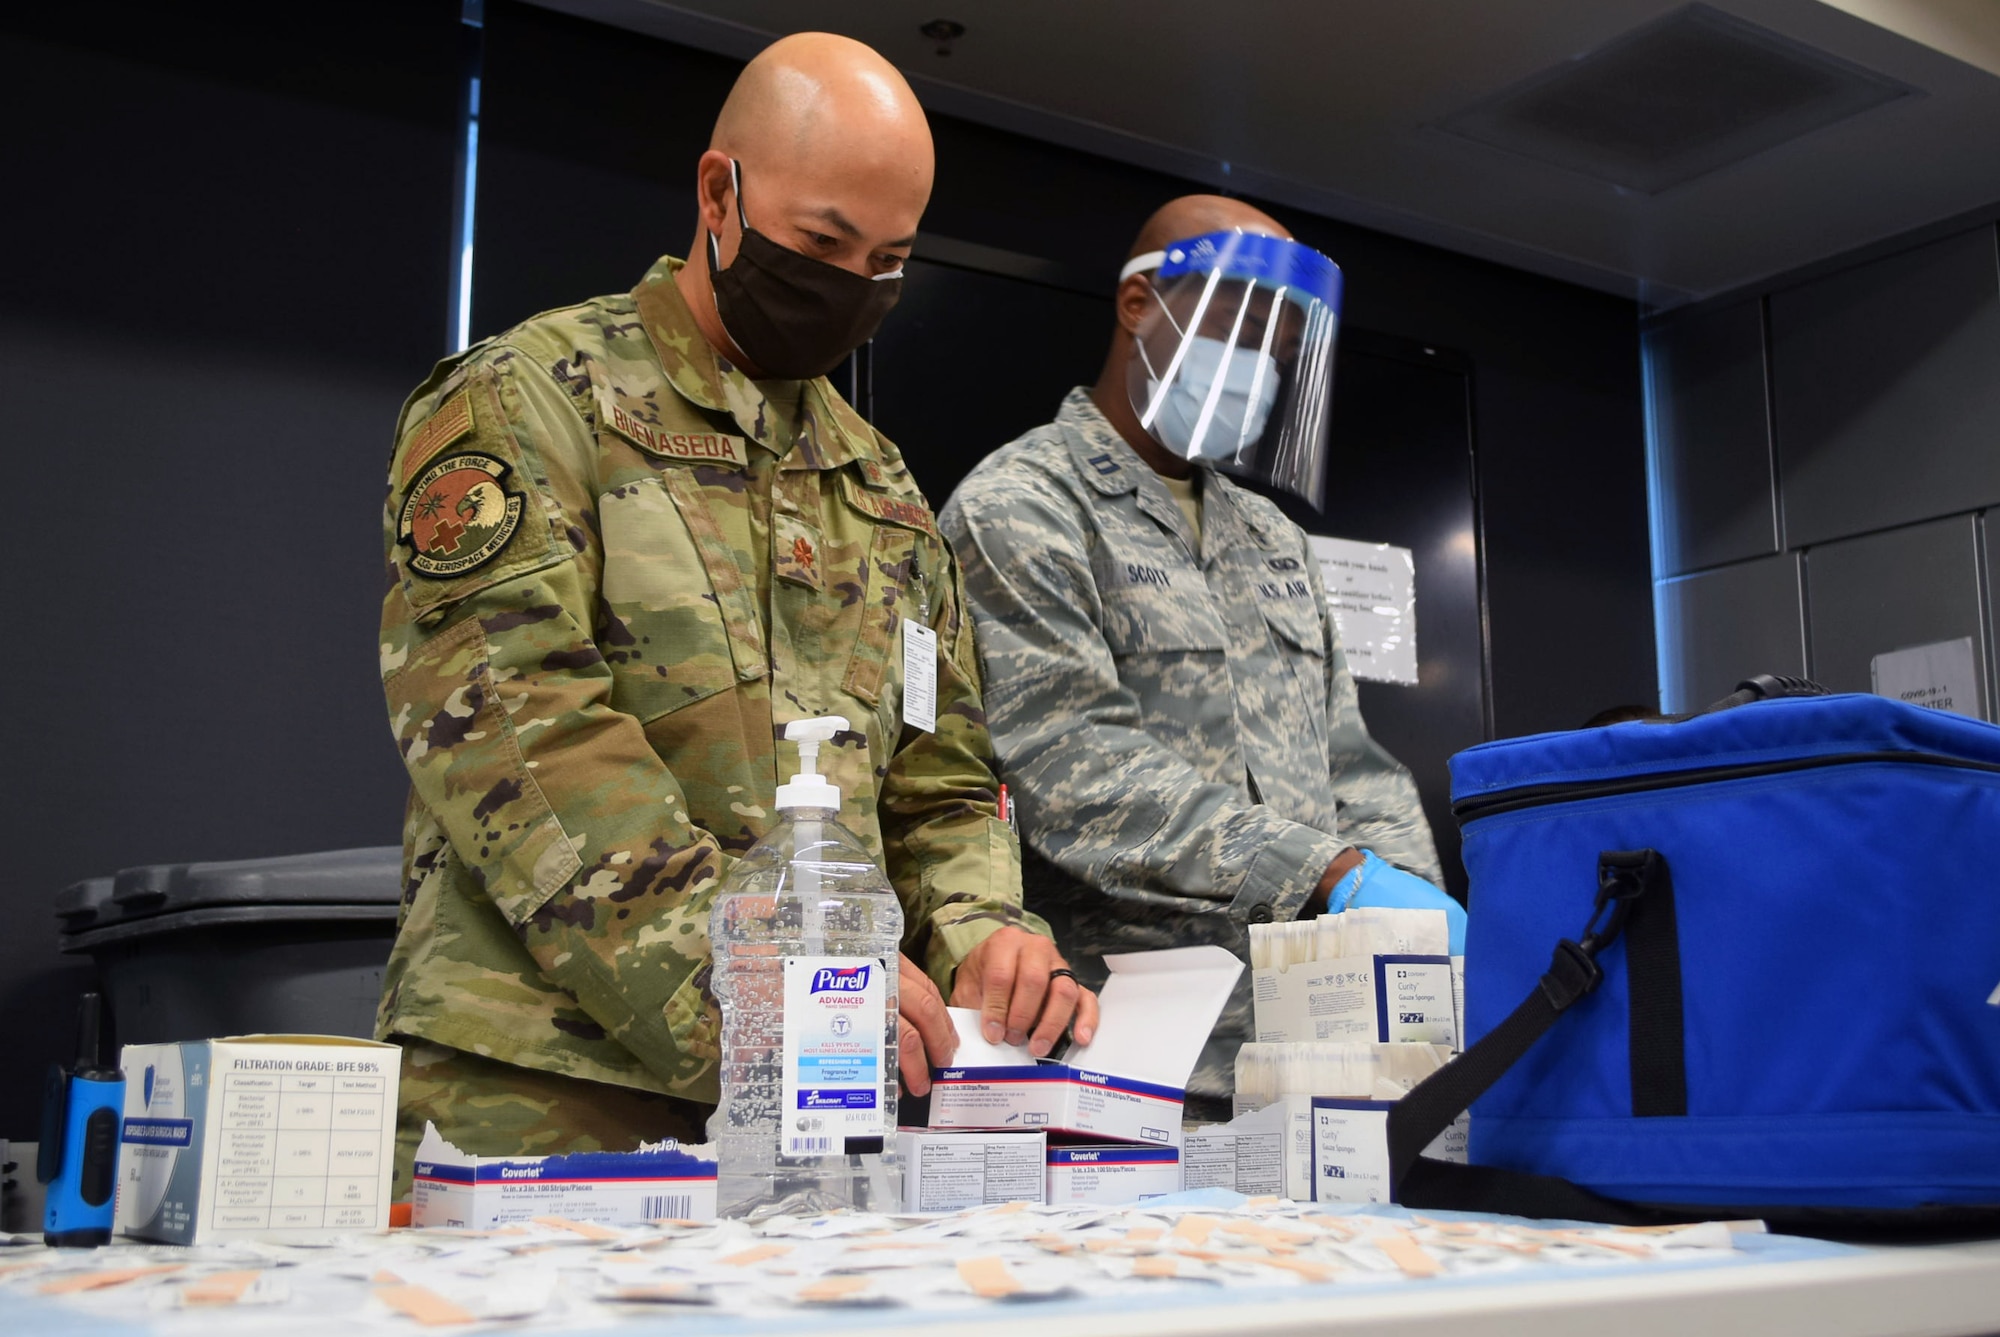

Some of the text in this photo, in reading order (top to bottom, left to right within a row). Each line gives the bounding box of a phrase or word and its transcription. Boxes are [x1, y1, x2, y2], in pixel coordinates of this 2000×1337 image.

[614, 405, 737, 460] BUENASEDA
[404, 457, 491, 522] QUALIFYING THE FORCE
[433, 551, 486, 571] AEROSPACE
[485, 513, 517, 552] MEDICINE
[1127, 563, 1171, 588] SCOTT
[1286, 580, 1310, 599] AIR
[818, 969, 866, 989] Purell
[819, 997, 865, 1005] ADVANCED
[1416, 994, 1435, 1002] Sponges
[234, 1059, 380, 1073] FILTRATION GRADE: BFE 98%
[233, 1079, 377, 1089] Classification Target Test Method
[1112, 1092, 1141, 1103] Strips/Pieces
[1444, 1130, 1466, 1142] Curity
[1336, 1145, 1356, 1154] Sponges
[1445, 1144, 1464, 1152] Gauze
[510, 1184, 519, 1192] in.
[538, 1184, 550, 1192] 100
[551, 1184, 593, 1192] Strips/Pieces
